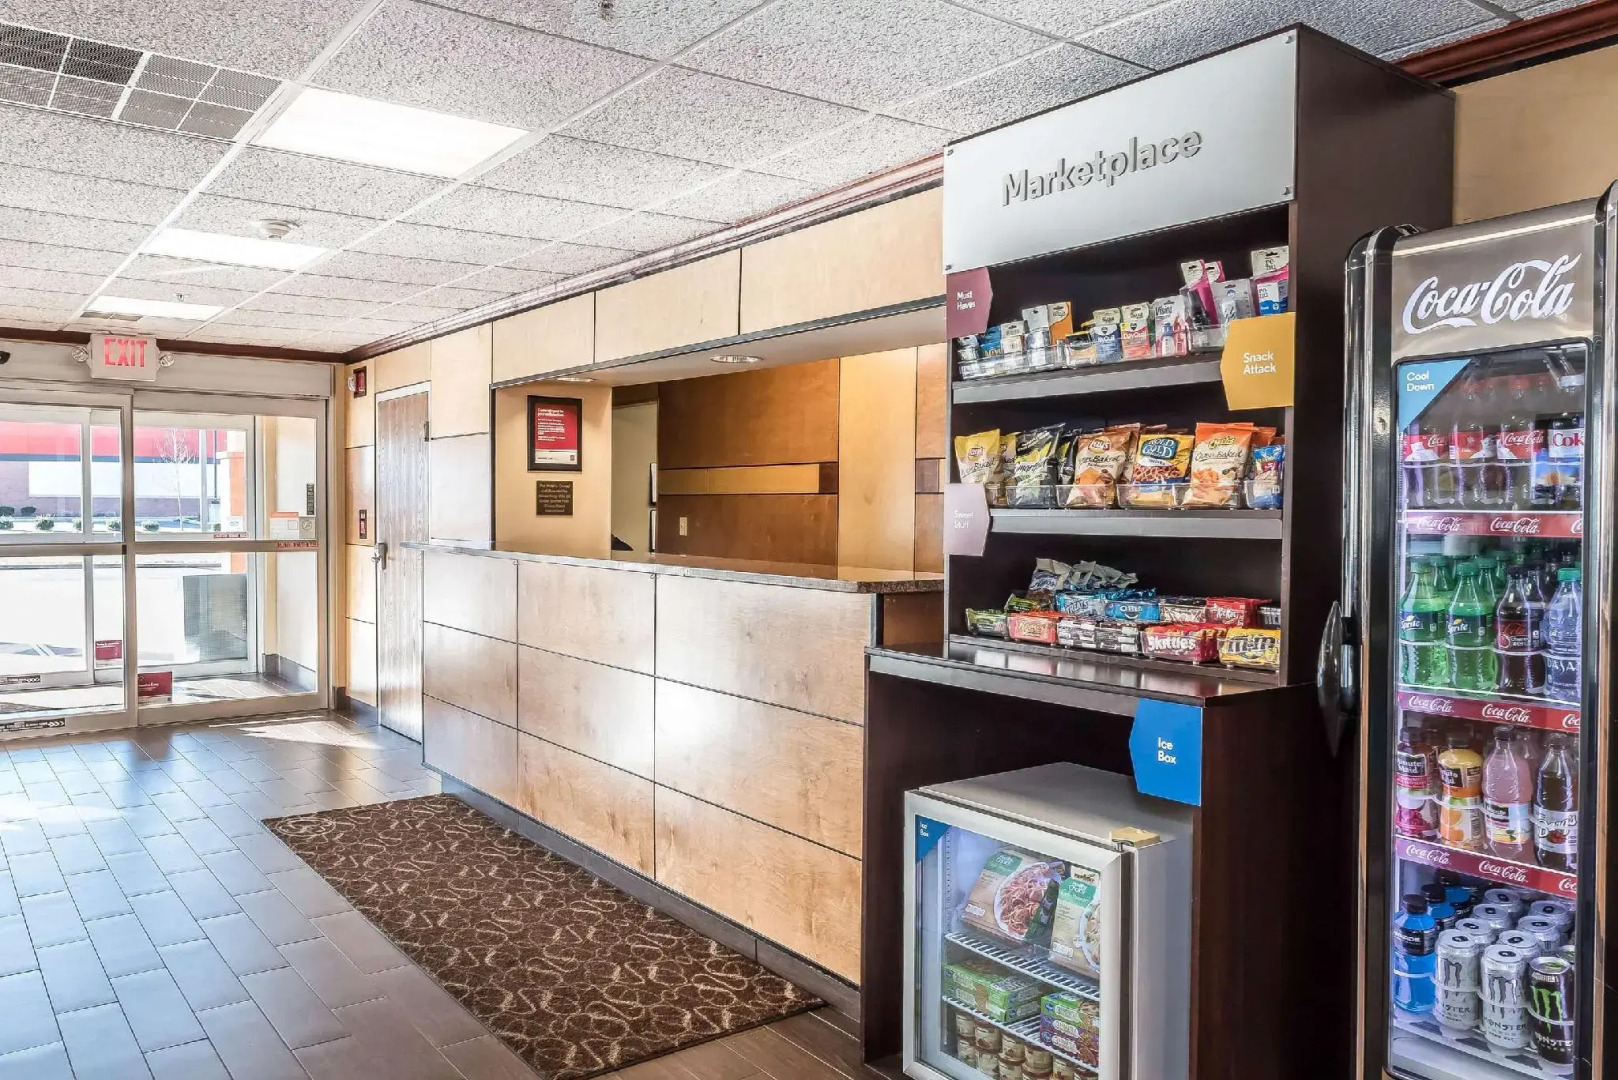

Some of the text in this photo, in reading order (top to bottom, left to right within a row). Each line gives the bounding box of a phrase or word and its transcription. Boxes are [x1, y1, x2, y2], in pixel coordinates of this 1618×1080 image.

[1003, 131, 1202, 207] Marketplace
[957, 290, 973, 300] Must
[1402, 253, 1582, 335] Coca-Cola
[957, 301, 976, 311] Haves
[104, 338, 148, 367] EXIT
[1243, 350, 1274, 363] Snack
[1243, 364, 1276, 375] Attack
[1407, 371, 1430, 382] Cool
[1407, 382, 1435, 393] Down
[1552, 432, 1583, 447] Cok
[1447, 623, 1468, 634] Sprite
[1148, 636, 1197, 651] Skittles
[1157, 737, 1173, 750] Ice
[1157, 750, 1177, 765] Box
